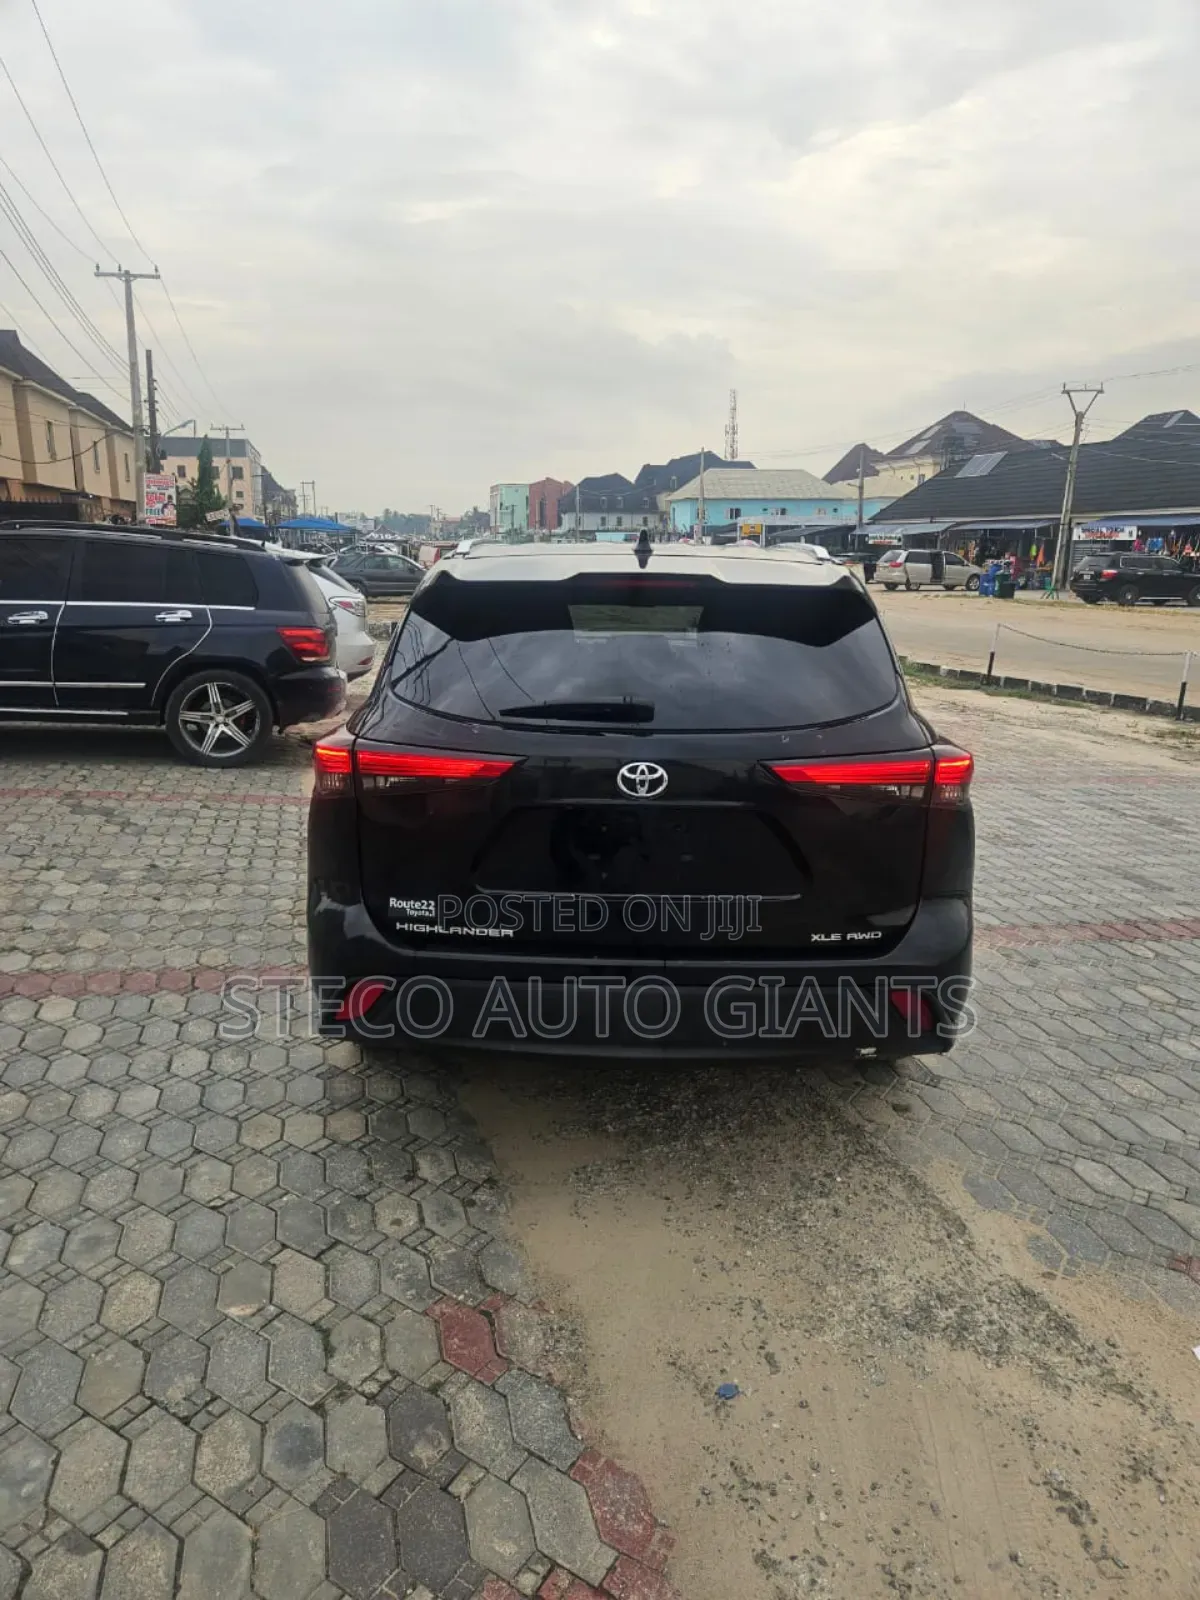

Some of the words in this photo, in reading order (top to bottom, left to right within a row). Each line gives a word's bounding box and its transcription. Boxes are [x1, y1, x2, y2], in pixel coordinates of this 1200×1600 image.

[389, 897, 436, 910] Route22
[396, 922, 514, 937] HIGHLANDER
[811, 933, 841, 942] XLE
[847, 931, 882, 940] AWD
